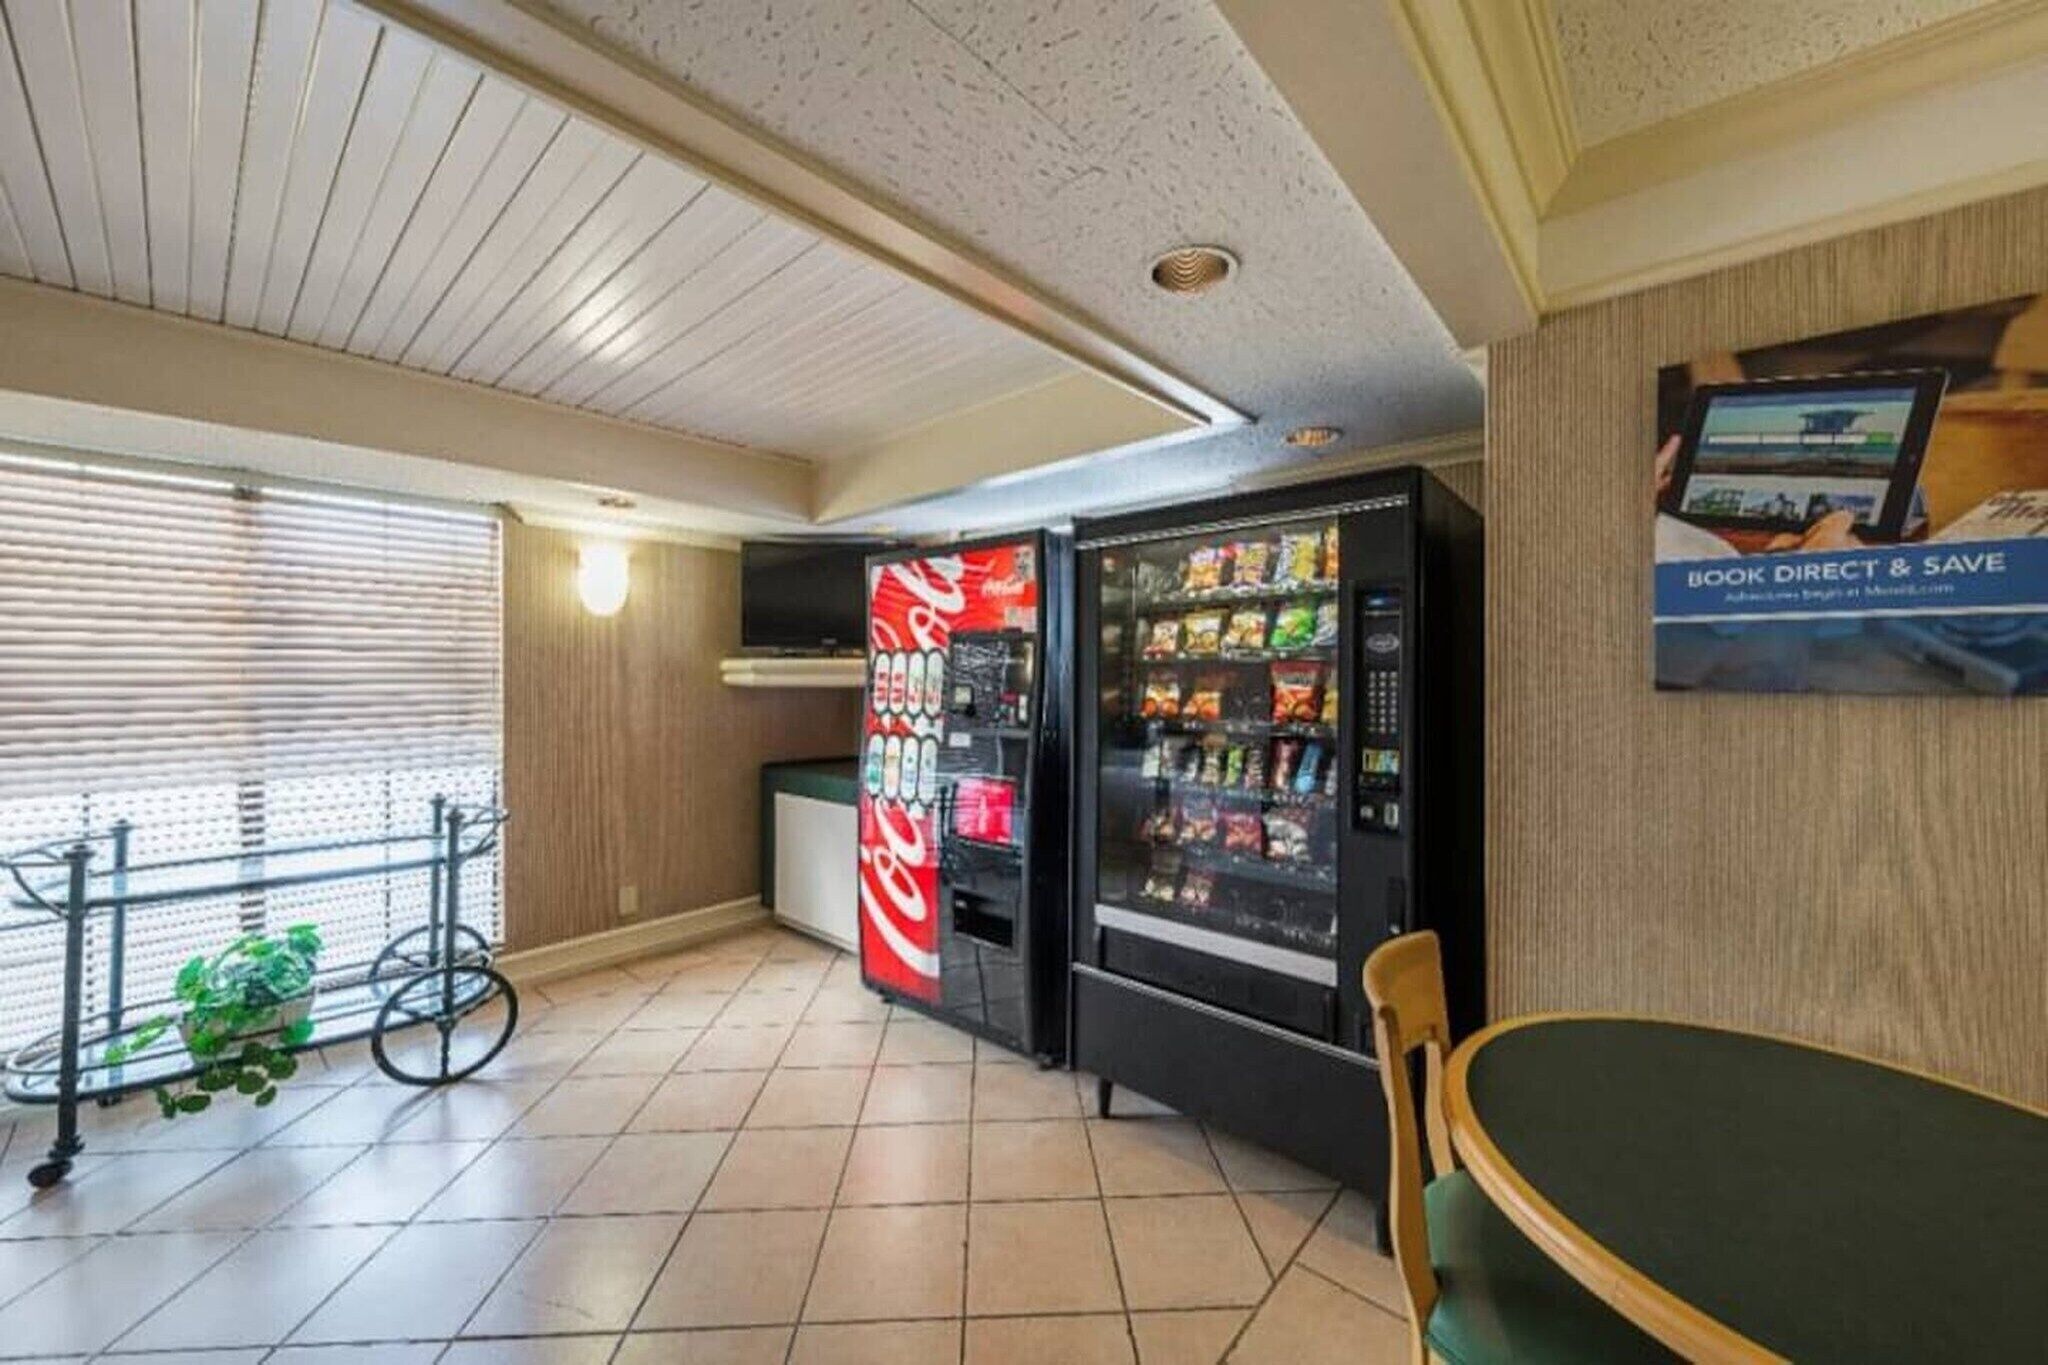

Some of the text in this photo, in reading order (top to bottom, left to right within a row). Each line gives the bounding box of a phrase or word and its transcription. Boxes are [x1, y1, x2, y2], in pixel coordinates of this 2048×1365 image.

[1688, 552, 2007, 588] BOOK DIRECT & SAVE
